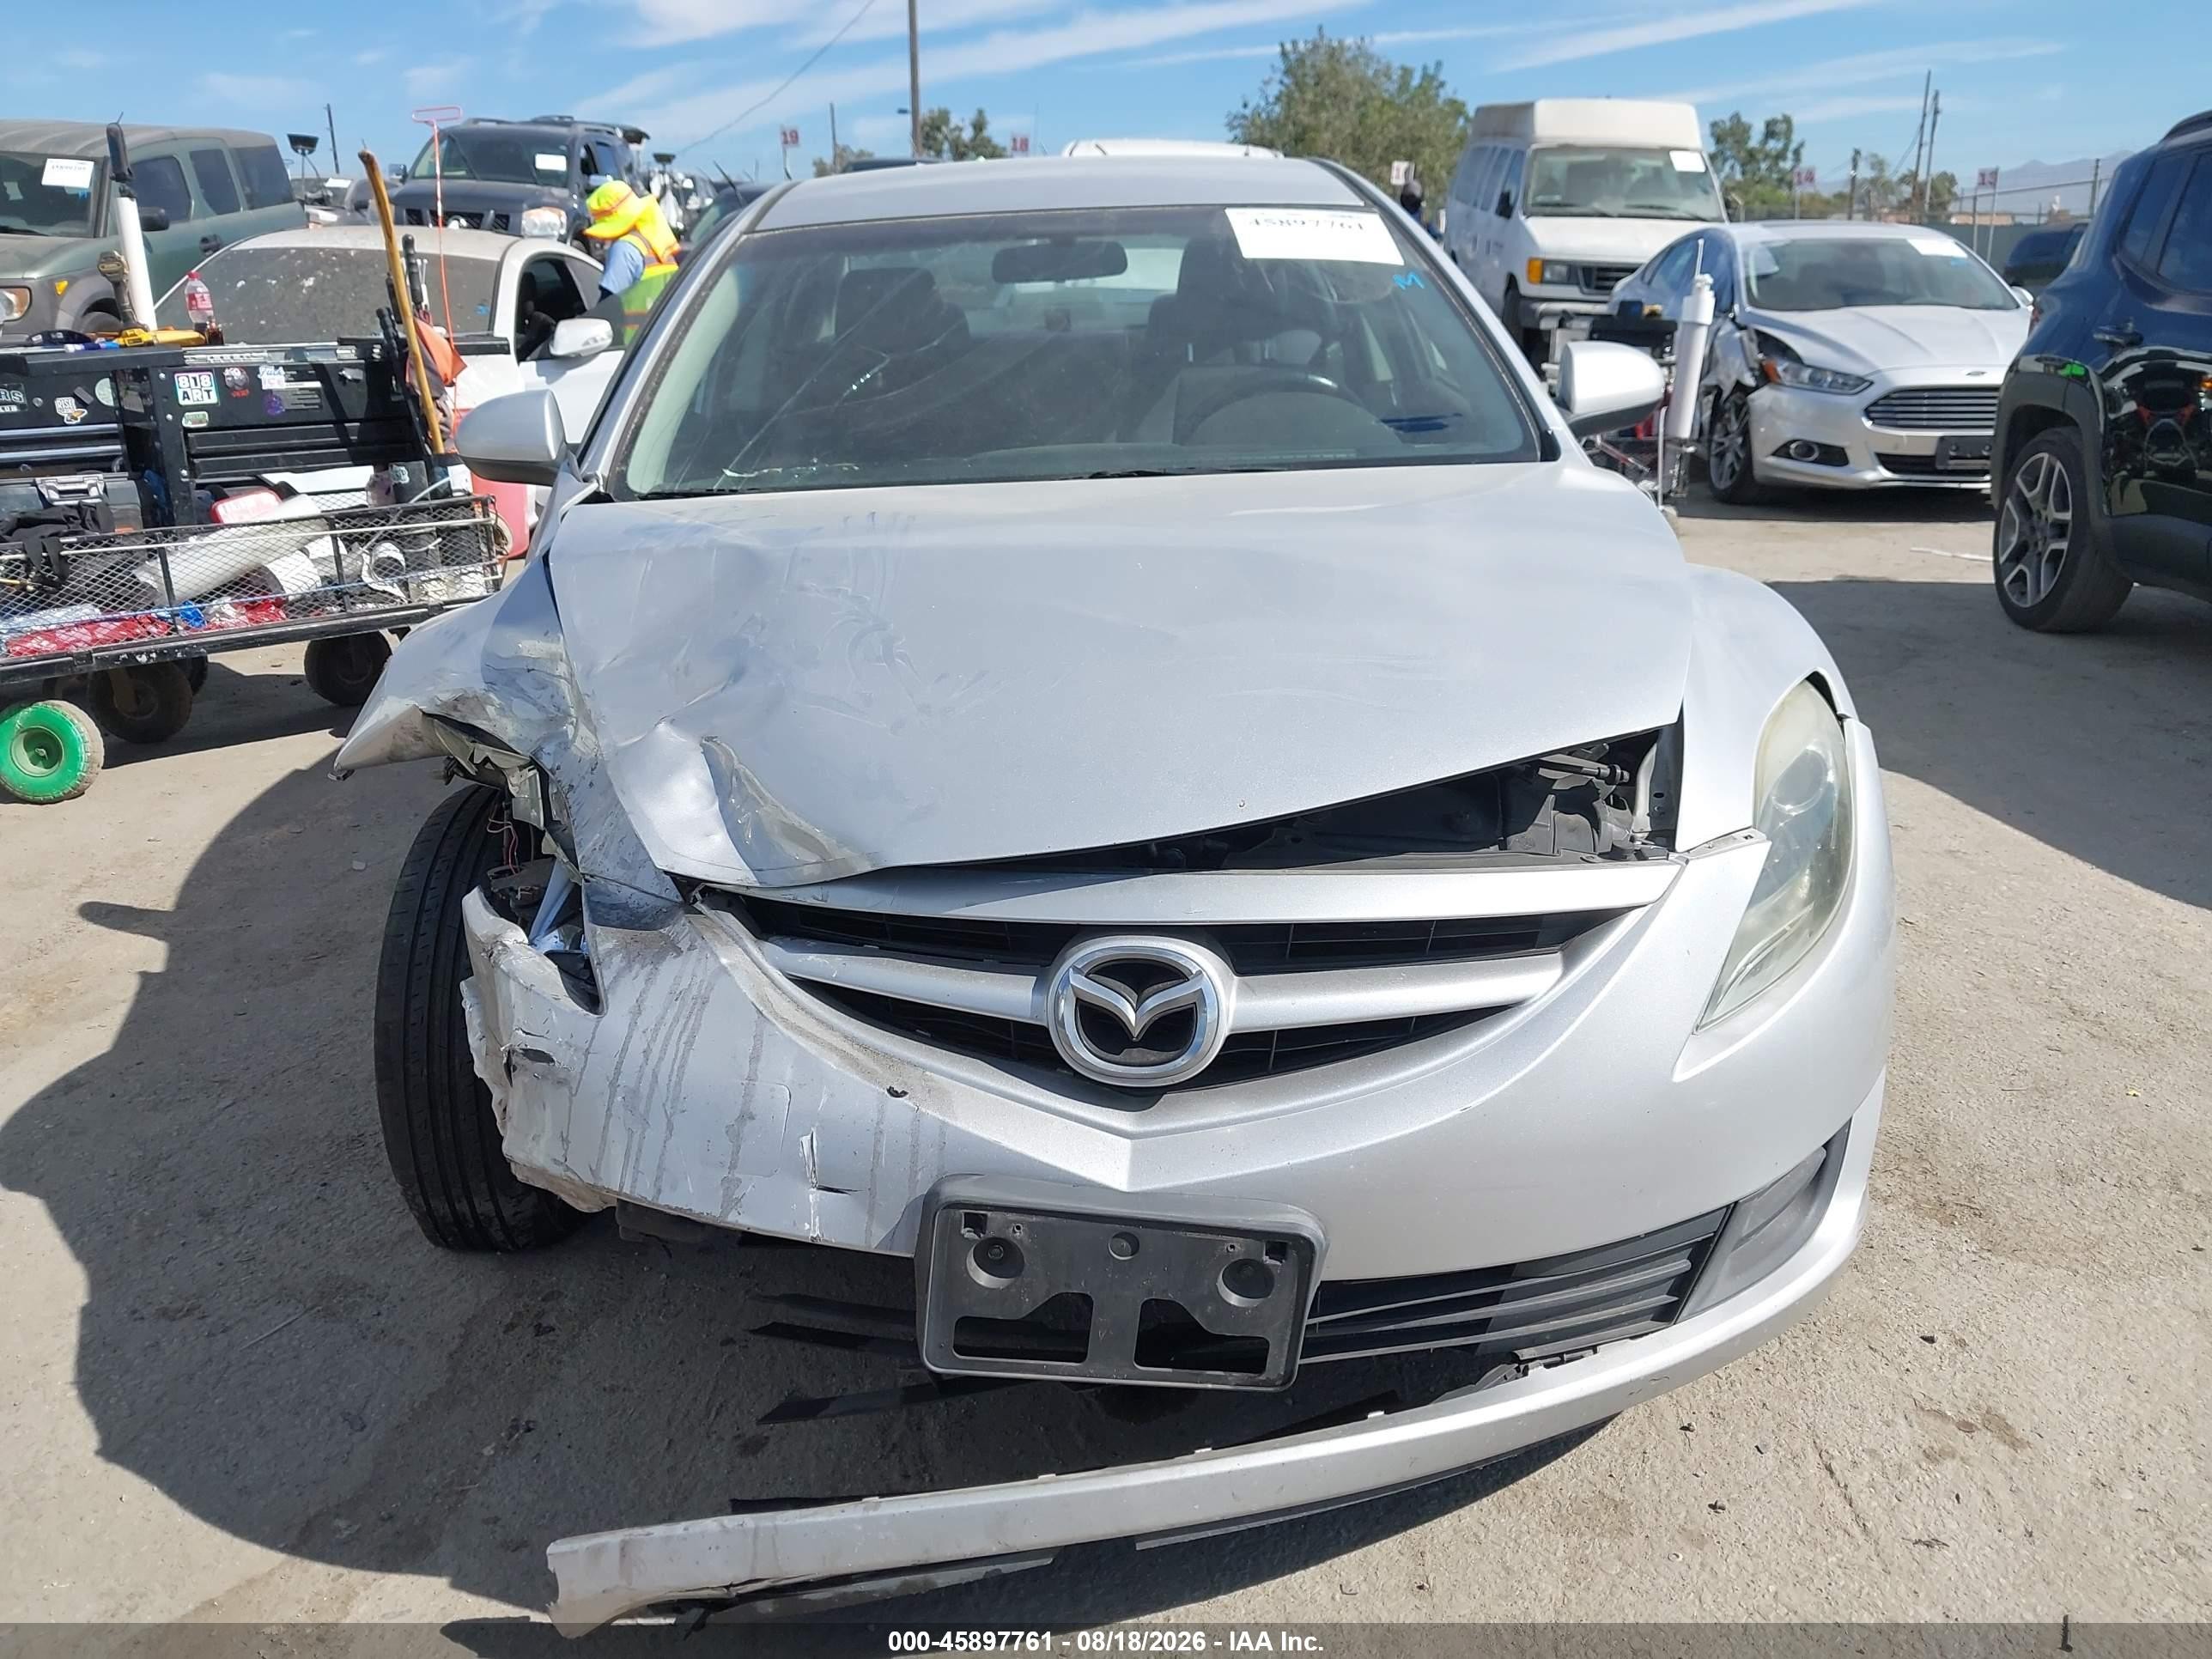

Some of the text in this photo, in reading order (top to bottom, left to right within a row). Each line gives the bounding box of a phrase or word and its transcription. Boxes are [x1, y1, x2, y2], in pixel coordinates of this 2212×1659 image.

[782, 130, 799, 145] 19
[178, 375, 212, 389] 818
[181, 389, 213, 402] ART
